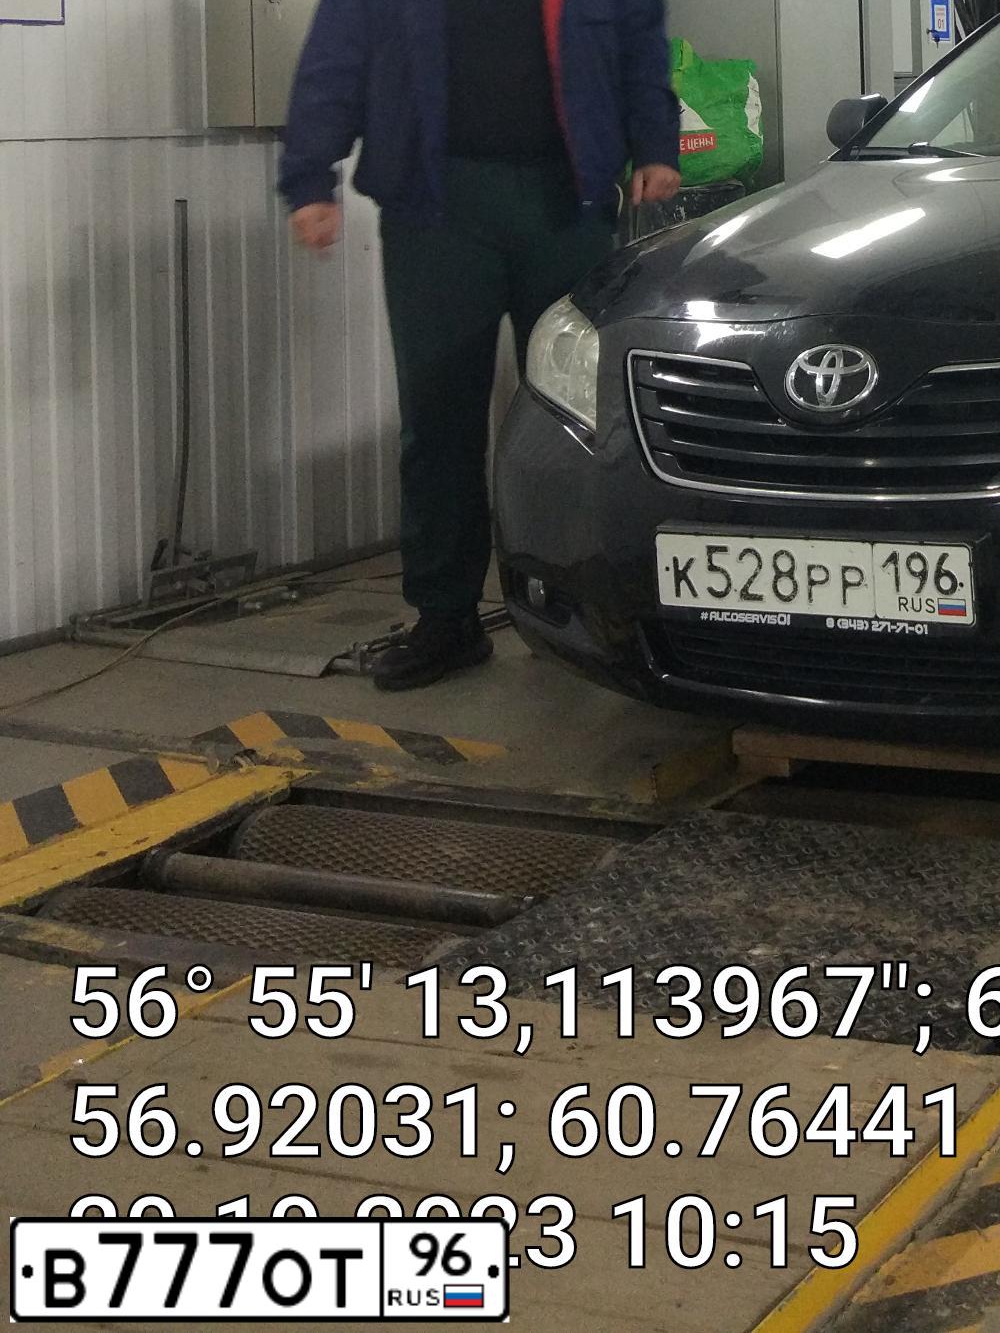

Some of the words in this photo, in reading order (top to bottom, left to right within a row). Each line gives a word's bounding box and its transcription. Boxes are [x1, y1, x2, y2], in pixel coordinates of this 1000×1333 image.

[687, 136, 714, 150] ЦЕНЫ
[672, 544, 865, 605] К528РР
[882, 550, 959, 596] 196
[898, 596, 936, 613] RUS
[825, 617, 835, 629] 8
[837, 618, 869, 631] (343)
[871, 620, 929, 635] 271-71-01
